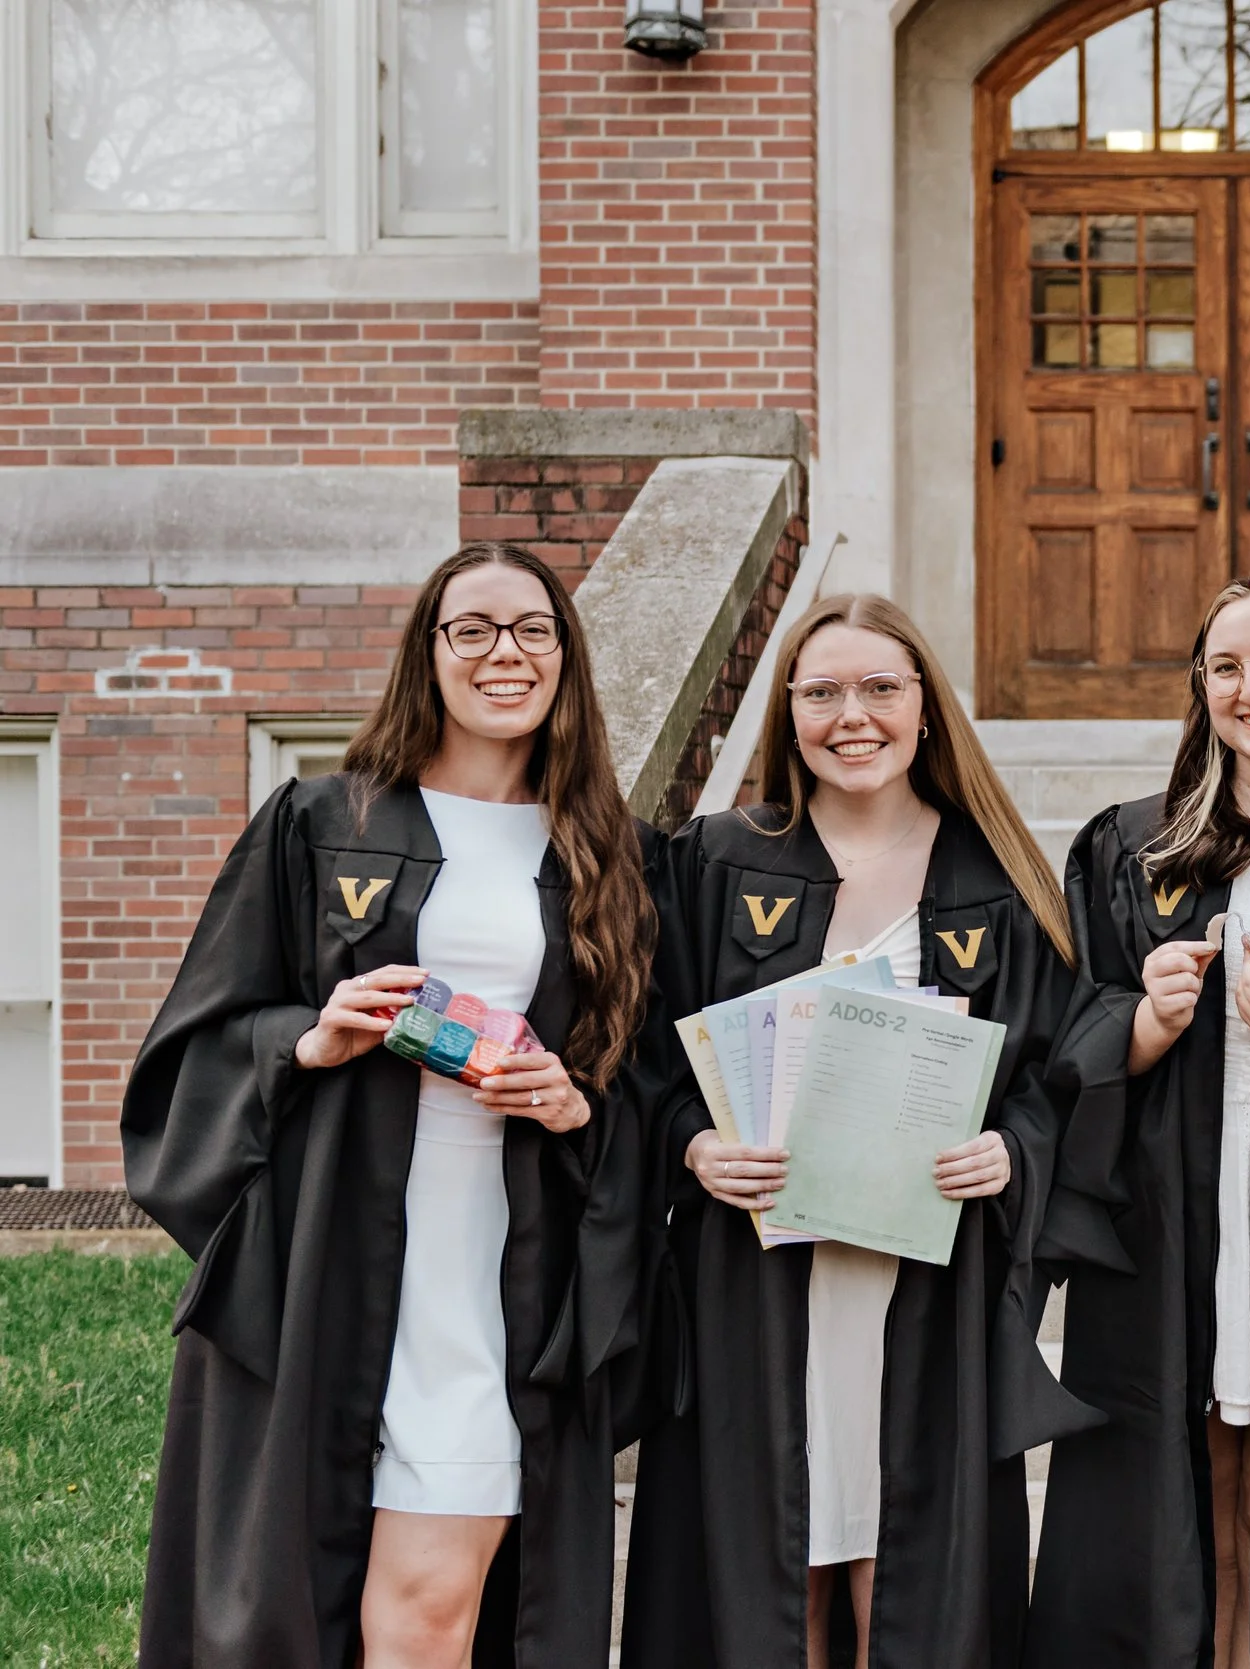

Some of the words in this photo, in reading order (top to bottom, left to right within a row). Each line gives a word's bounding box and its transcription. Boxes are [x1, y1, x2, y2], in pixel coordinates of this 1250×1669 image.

[337, 877, 392, 919] V
[742, 895, 796, 936] V
[1154, 883, 1190, 916] V
[935, 927, 986, 969] V
[828, 1002, 907, 1033] ADOS-2
